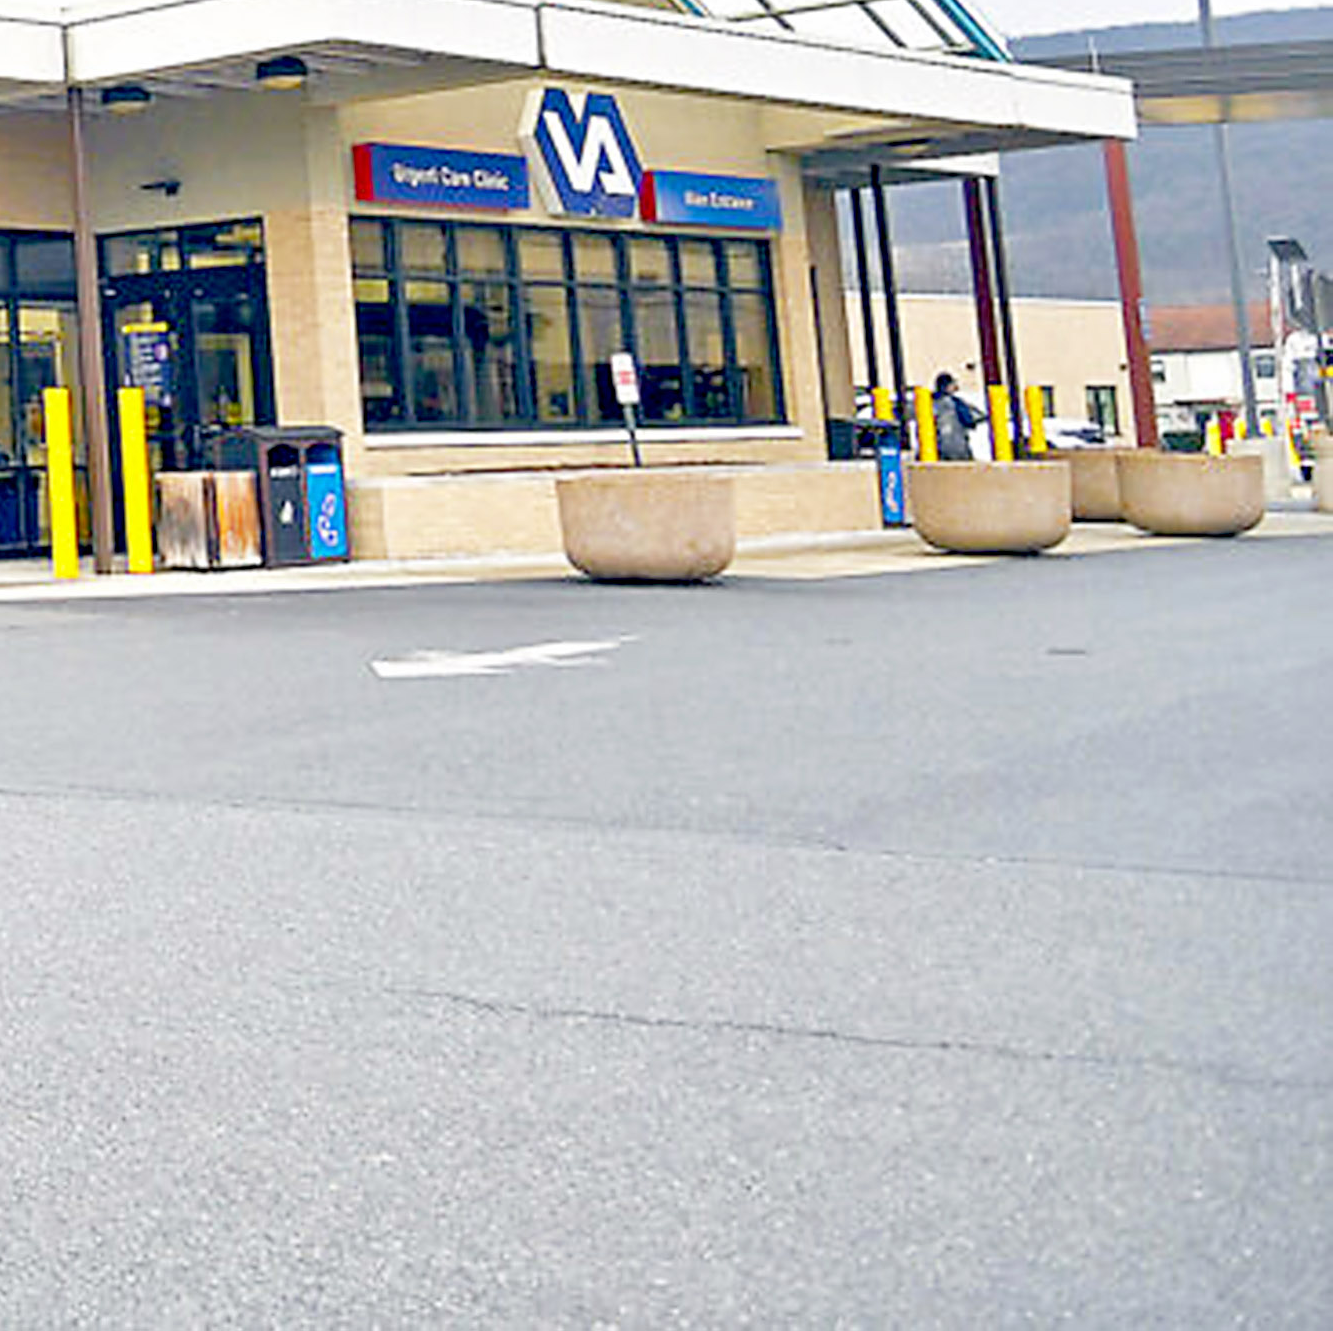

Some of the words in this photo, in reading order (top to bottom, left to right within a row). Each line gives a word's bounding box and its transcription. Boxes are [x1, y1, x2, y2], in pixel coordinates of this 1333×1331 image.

[393, 162, 438, 187] Urgent
[440, 166, 470, 187] Care
[473, 169, 509, 191] Clinic
[542, 110, 636, 195] VA
